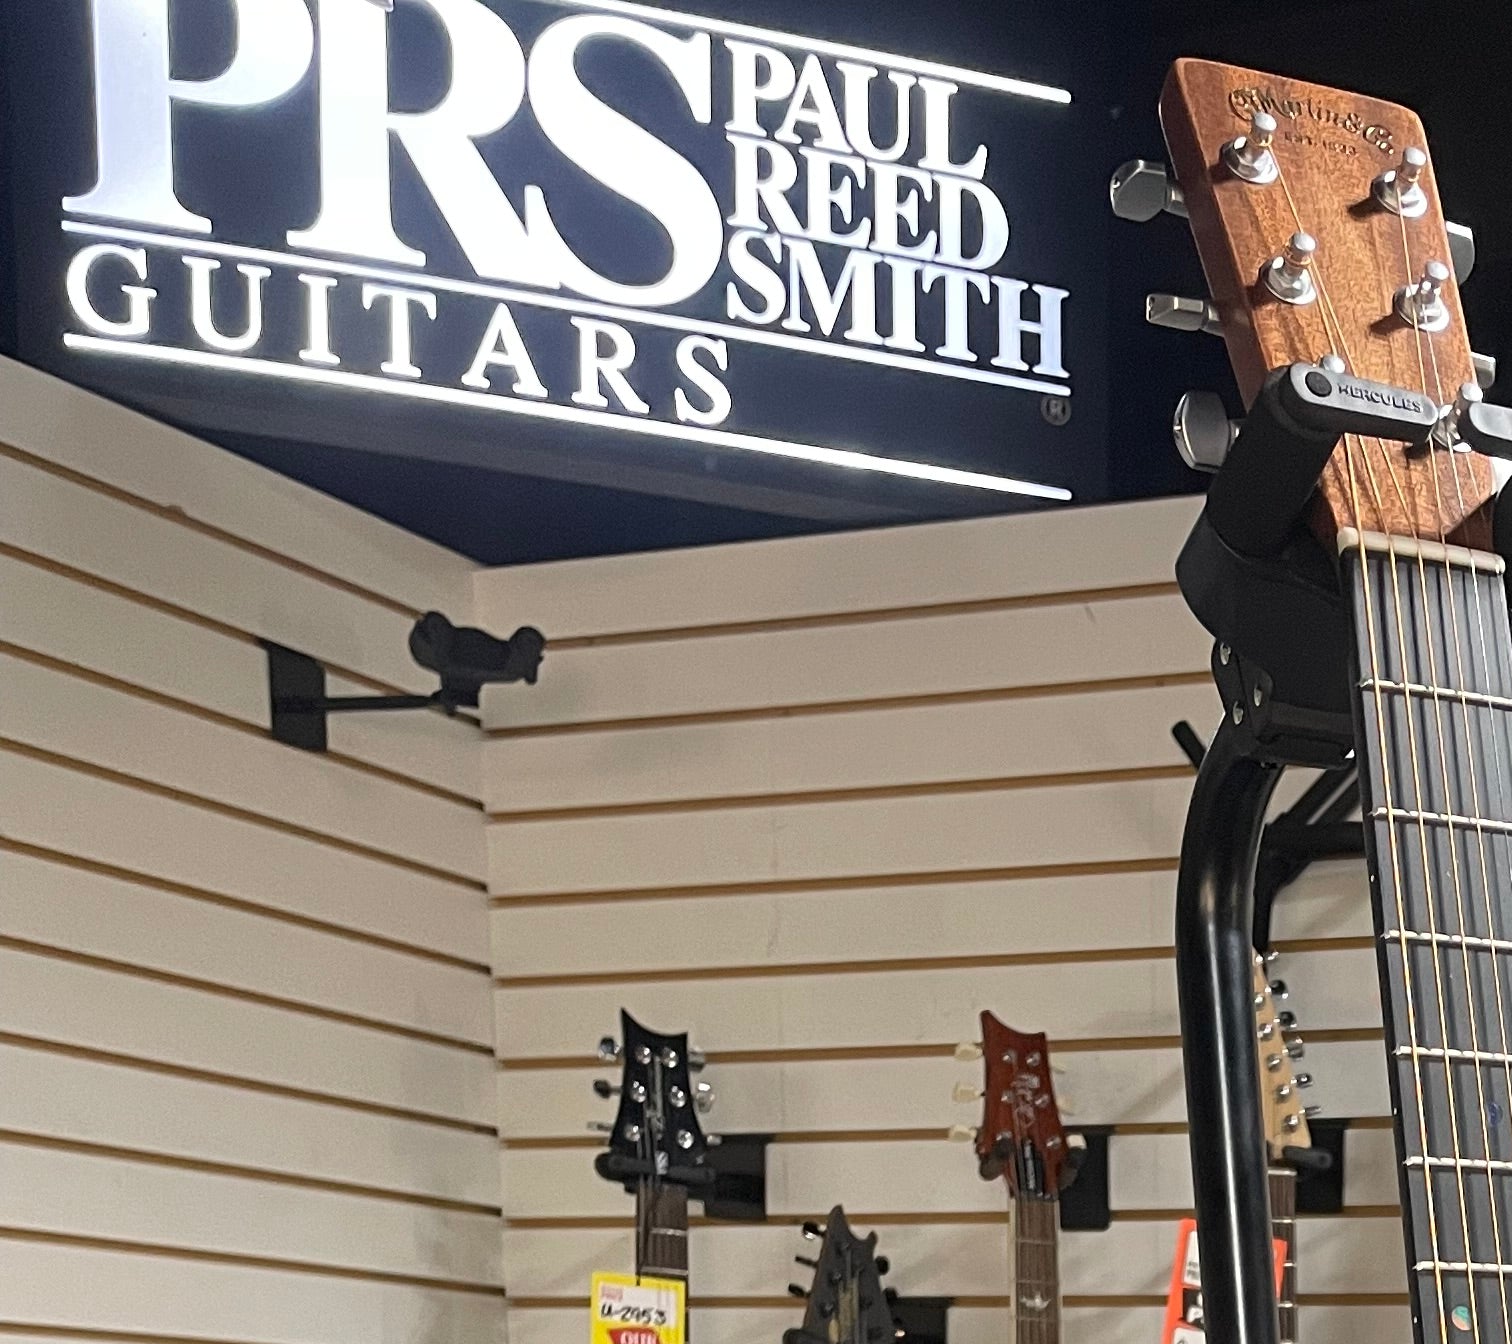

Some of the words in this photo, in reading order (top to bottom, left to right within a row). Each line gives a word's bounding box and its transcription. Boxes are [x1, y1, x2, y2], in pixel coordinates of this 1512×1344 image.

[62, 0, 724, 307] PRS
[722, 36, 991, 181] PAUL
[723, 133, 1010, 272] REED
[65, 242, 733, 427] GUITARS
[725, 227, 1071, 379] SMITH
[1338, 383, 1422, 413] HERCULES
